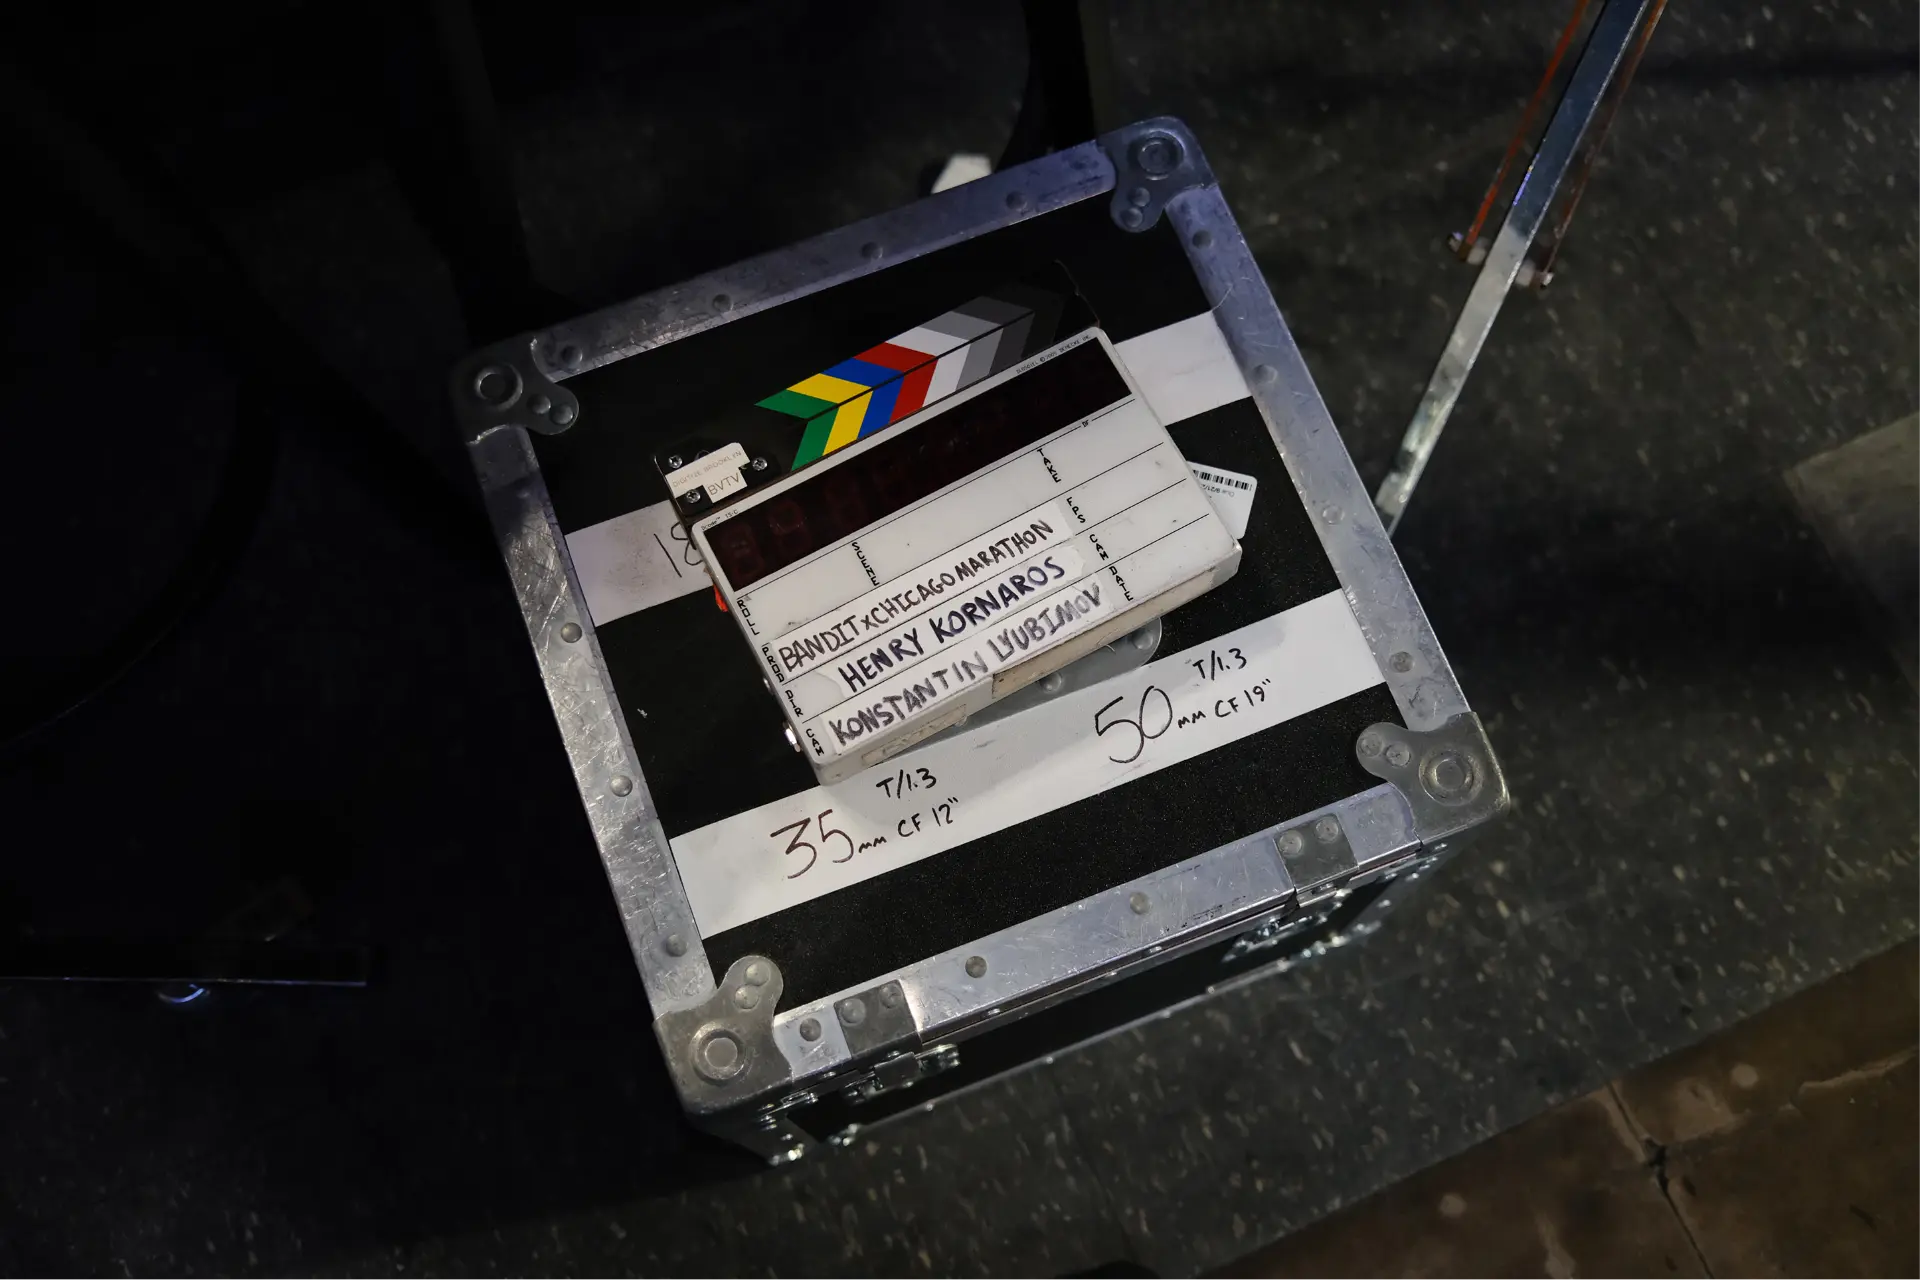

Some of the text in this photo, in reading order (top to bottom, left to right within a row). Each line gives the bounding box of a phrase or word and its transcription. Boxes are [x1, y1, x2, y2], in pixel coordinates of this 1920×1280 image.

[1037, 448, 1061, 483] TAKE
[707, 472, 740, 496] BVTV
[1067, 497, 1086, 524] FPS
[851, 541, 880, 586] SCENE
[954, 519, 1054, 582] MARATHON
[1089, 534, 1109, 561] CAM
[1108, 566, 1134, 602] DATE
[737, 600, 760, 636] ROLL
[838, 555, 1066, 693] HENRY KORNAROS
[828, 582, 1102, 747] KONSTANTIN LYUBIMOV
[1192, 647, 1247, 681] T/1.3
[1214, 696, 1239, 718] CF
[805, 728, 824, 756] CAM
[875, 767, 938, 799] T/1.3
[897, 813, 921, 838] CF
